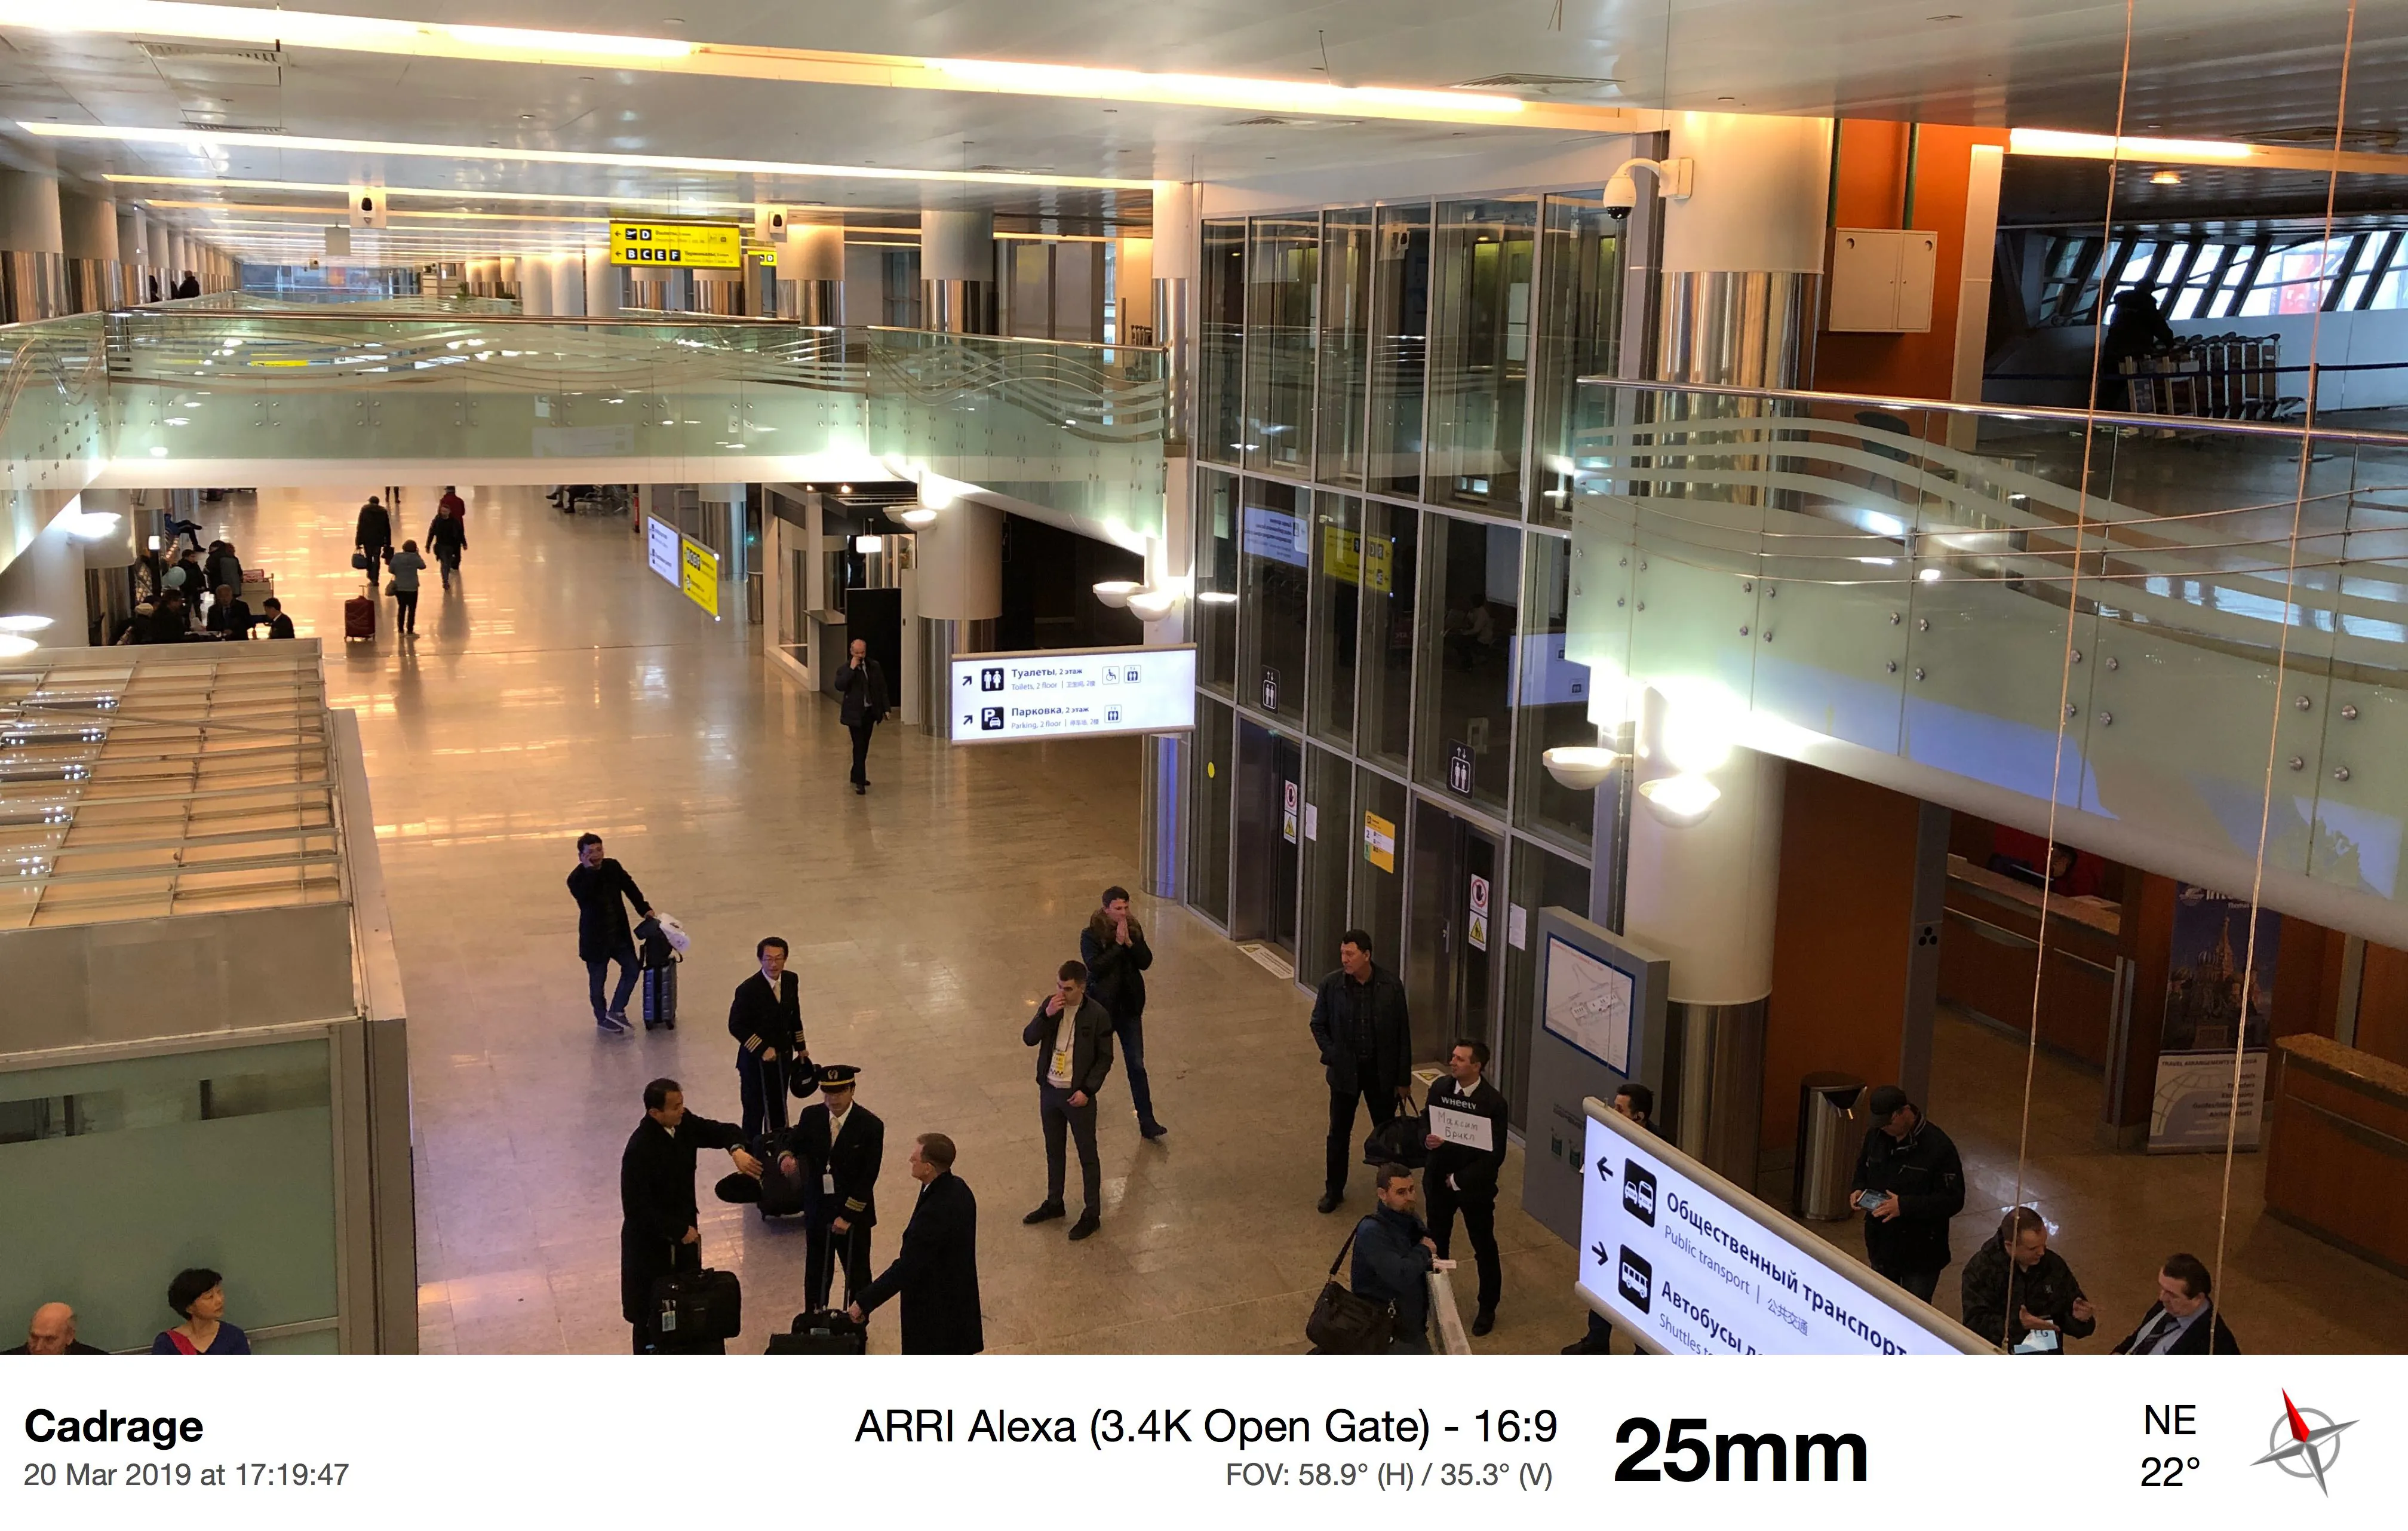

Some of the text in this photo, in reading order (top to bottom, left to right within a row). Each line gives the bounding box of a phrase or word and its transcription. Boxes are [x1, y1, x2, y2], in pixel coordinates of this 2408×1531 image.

[641, 231, 650, 239] D
[628, 250, 636, 259] B
[643, 250, 650, 259] C
[657, 251, 665, 259] E
[671, 251, 678, 260] F
[1011, 668, 1057, 679] Туалеты,
[1011, 707, 1064, 717] Парковка,
[1438, 1110, 1478, 1131] Максим
[1664, 1225, 1750, 1295] Public transport
[1667, 1192, 1908, 1355] Общественный транспорт
[1661, 1280, 1742, 1354] Автобусы
[1767, 1297, 1808, 1336] 公共交通
[1660, 1312, 1701, 1355] Shuttles
